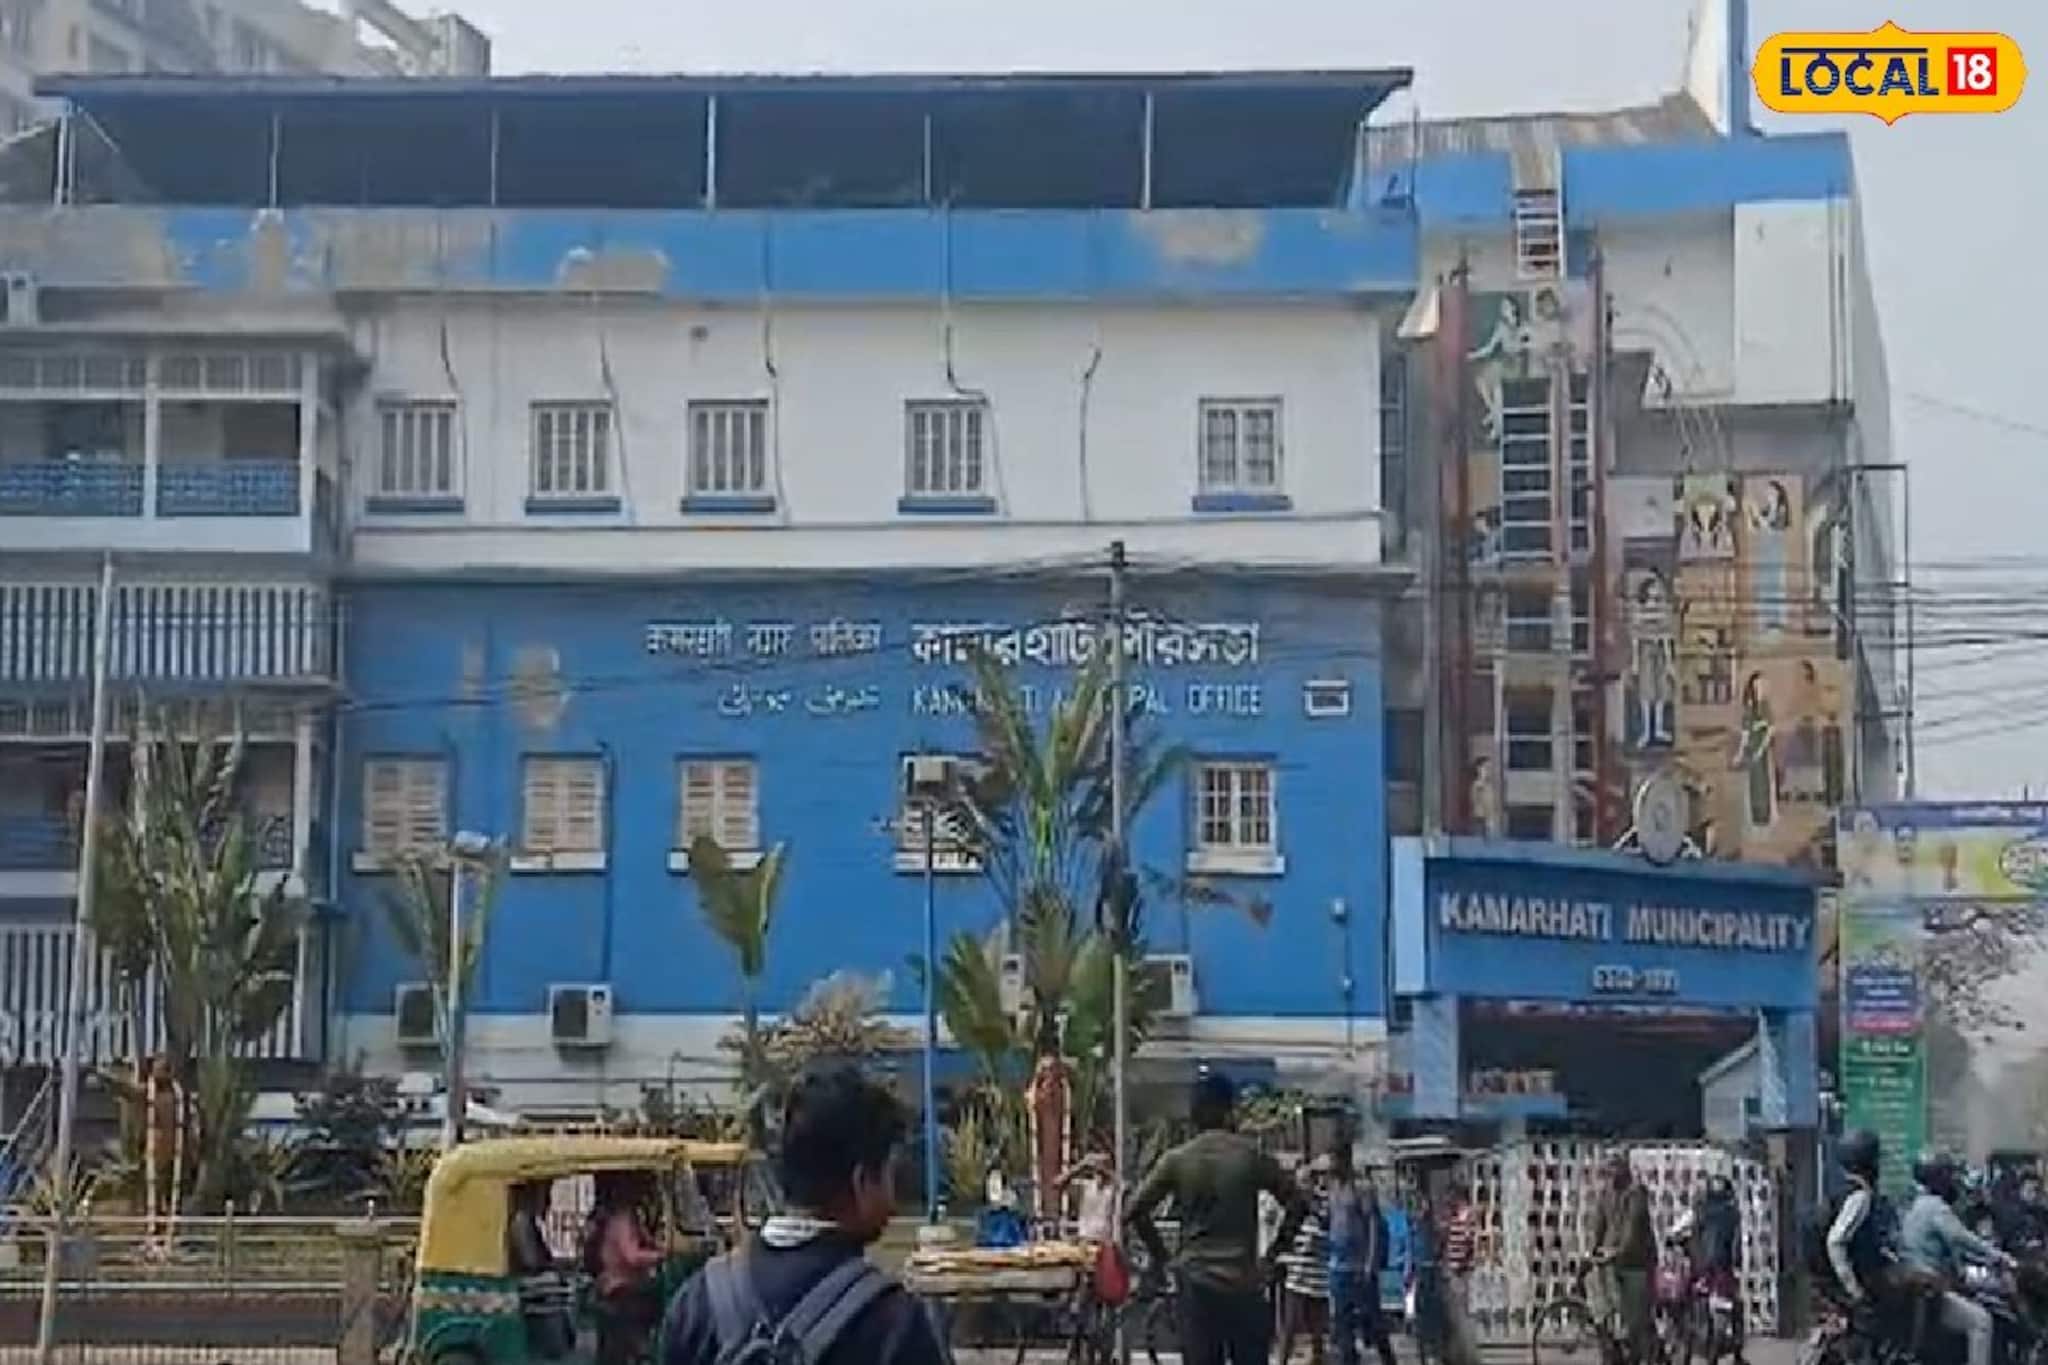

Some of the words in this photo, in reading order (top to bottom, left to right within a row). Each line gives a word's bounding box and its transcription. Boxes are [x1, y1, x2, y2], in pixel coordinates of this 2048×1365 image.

[1187, 684, 1264, 715] OFFICE
[1439, 891, 1612, 940] KAMARHATI
[1627, 906, 1811, 950] MUNICIPALITY
